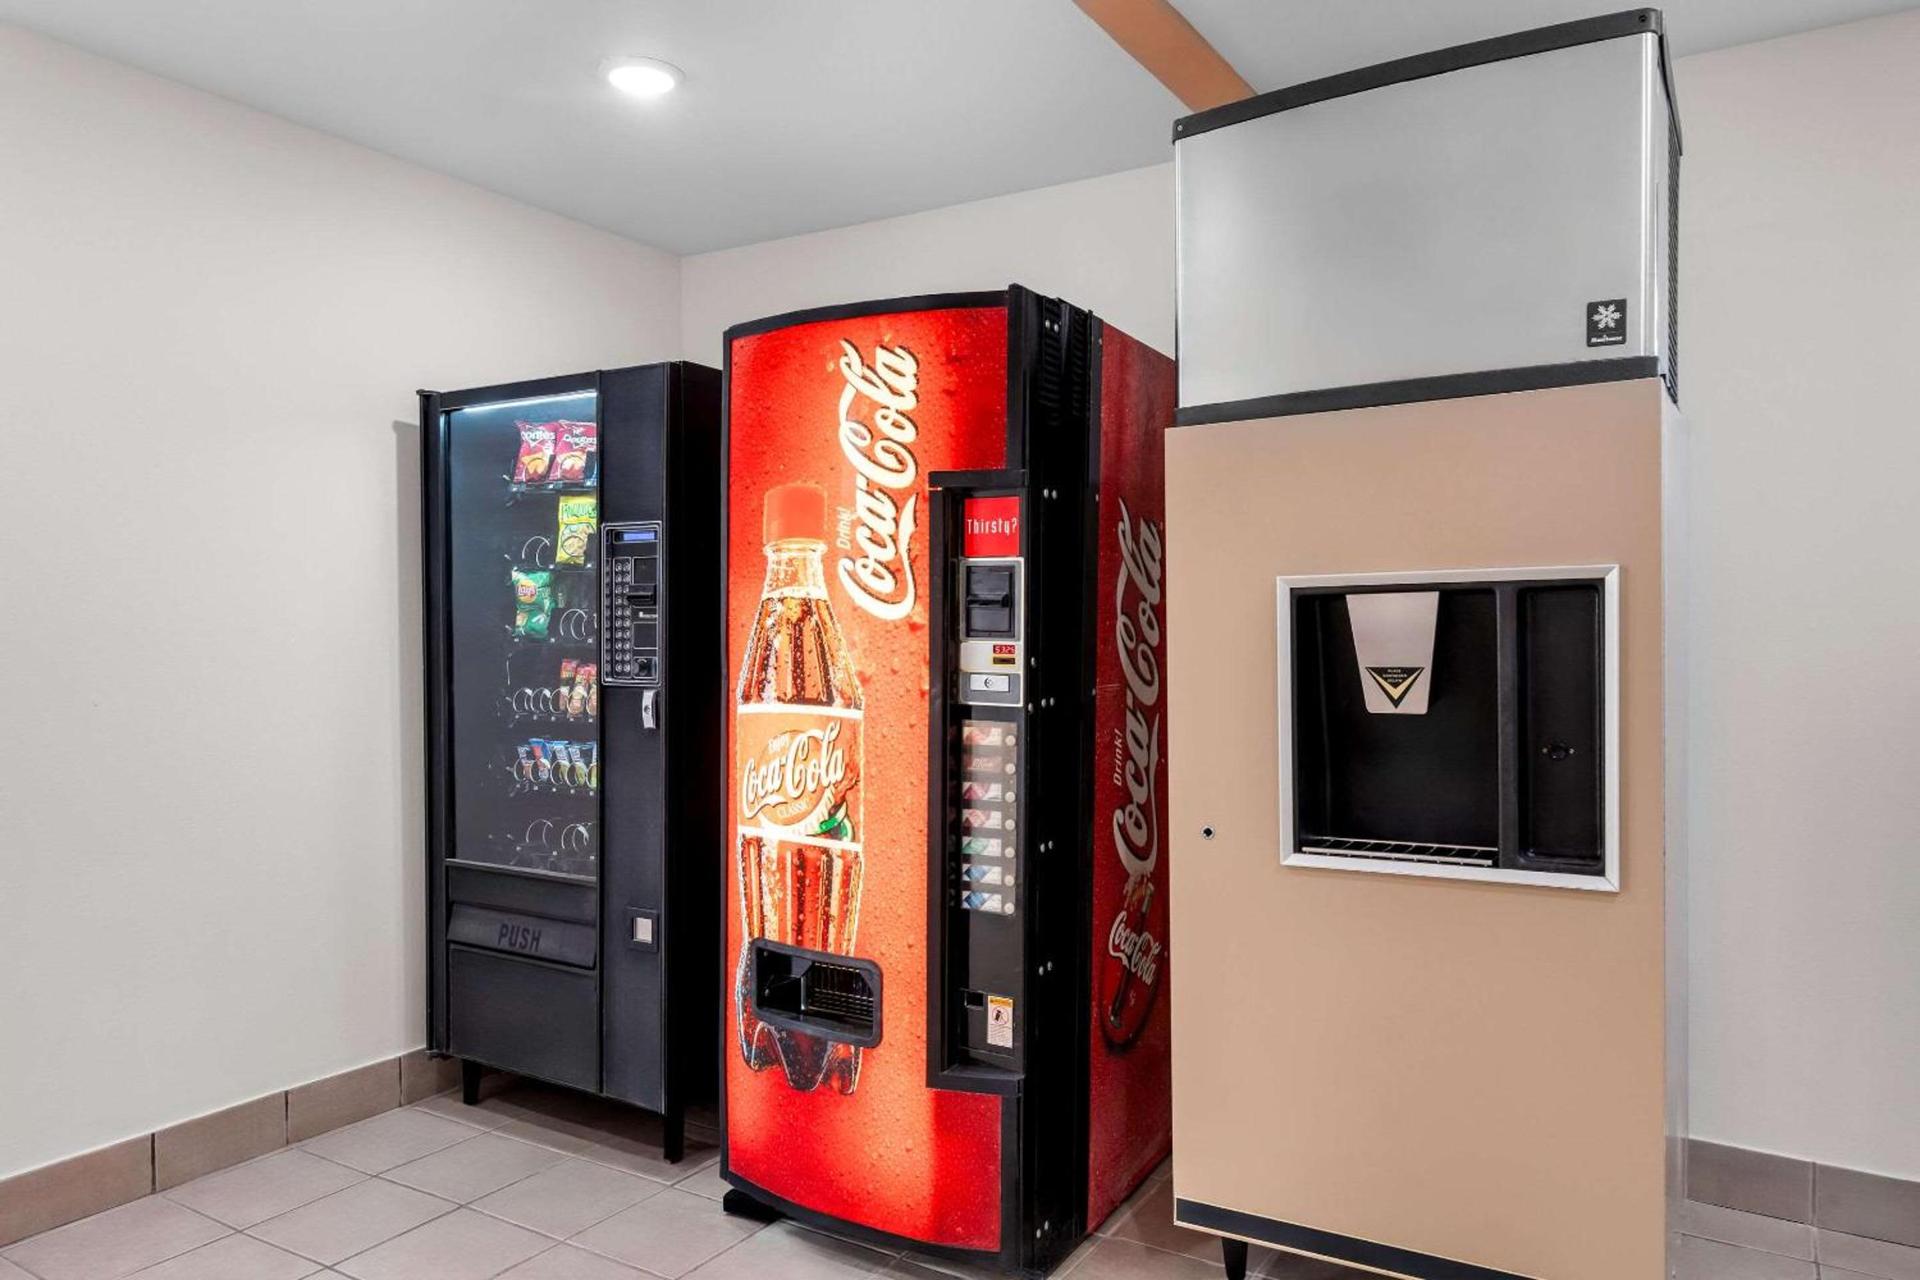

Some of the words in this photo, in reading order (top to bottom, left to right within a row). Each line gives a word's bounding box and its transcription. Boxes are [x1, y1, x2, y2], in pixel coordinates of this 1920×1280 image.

[838, 337, 919, 620] Coca-Cola
[966, 517, 1018, 536] Thirsty?
[1113, 497, 1161, 875] Coca-Cola
[742, 719, 846, 820] Coca-Cola
[1112, 728, 1123, 786] Drink!
[497, 922, 543, 952] PUSH
[1108, 911, 1162, 986] Coca-Cola
